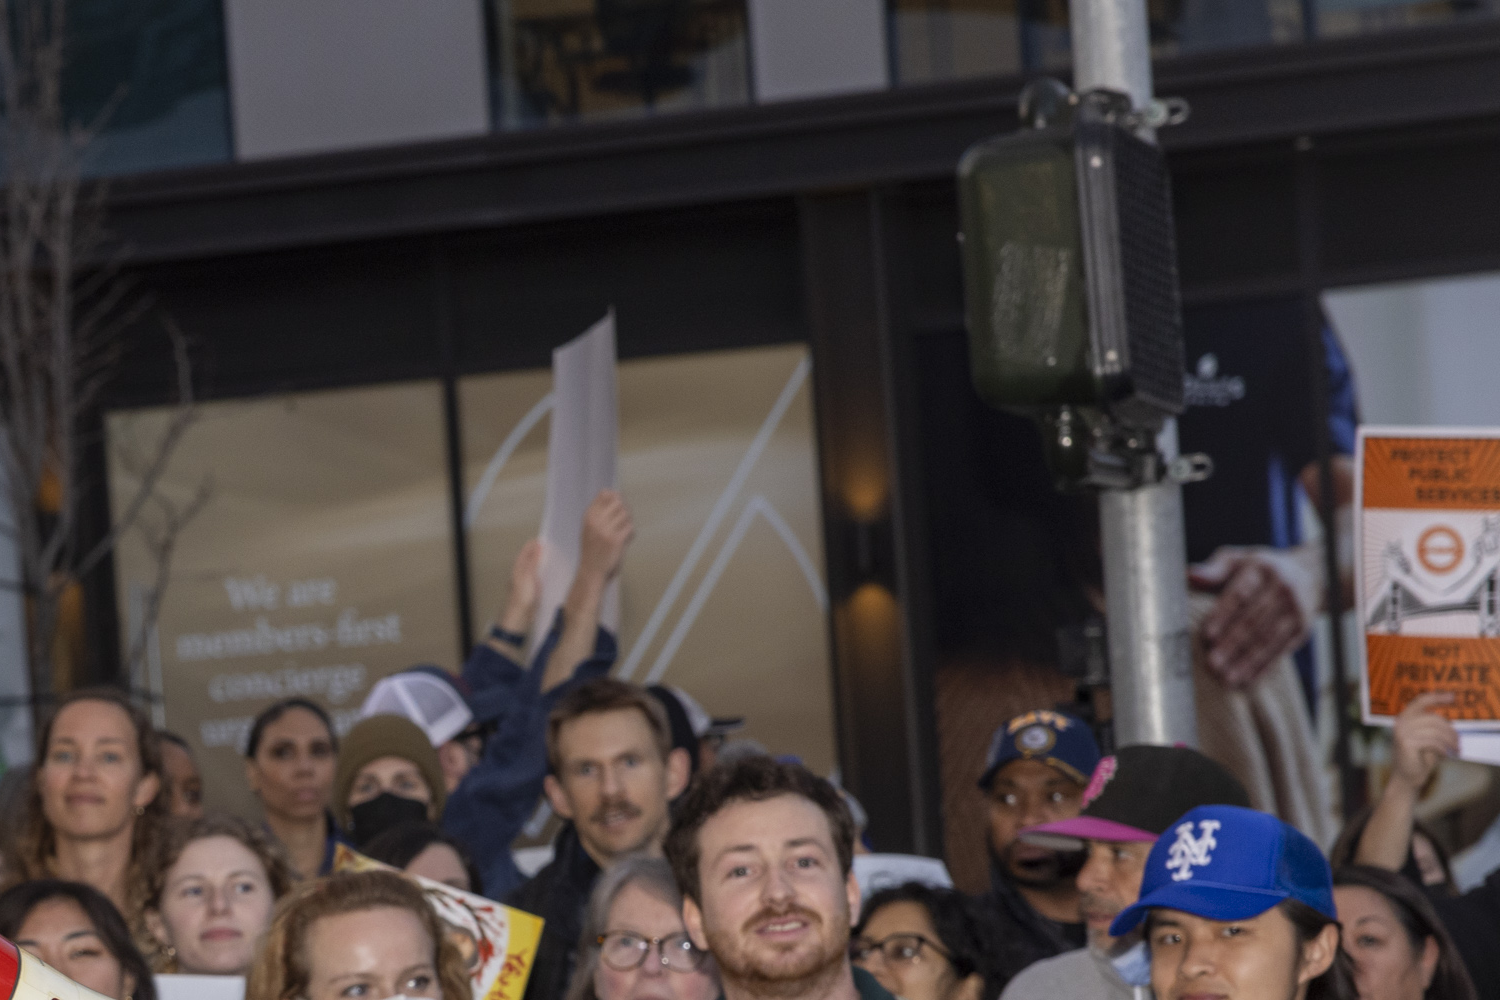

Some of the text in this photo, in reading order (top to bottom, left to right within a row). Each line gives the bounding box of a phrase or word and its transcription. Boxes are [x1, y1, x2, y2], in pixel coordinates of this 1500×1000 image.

[1390, 446, 1469, 463] PROTECT
[1408, 467, 1470, 484] PUBLIC
[224, 577, 337, 611] We are
[1422, 644, 1460, 659] NOT
[1396, 663, 1491, 683] PRIVATE
[209, 664, 366, 703] concierge
